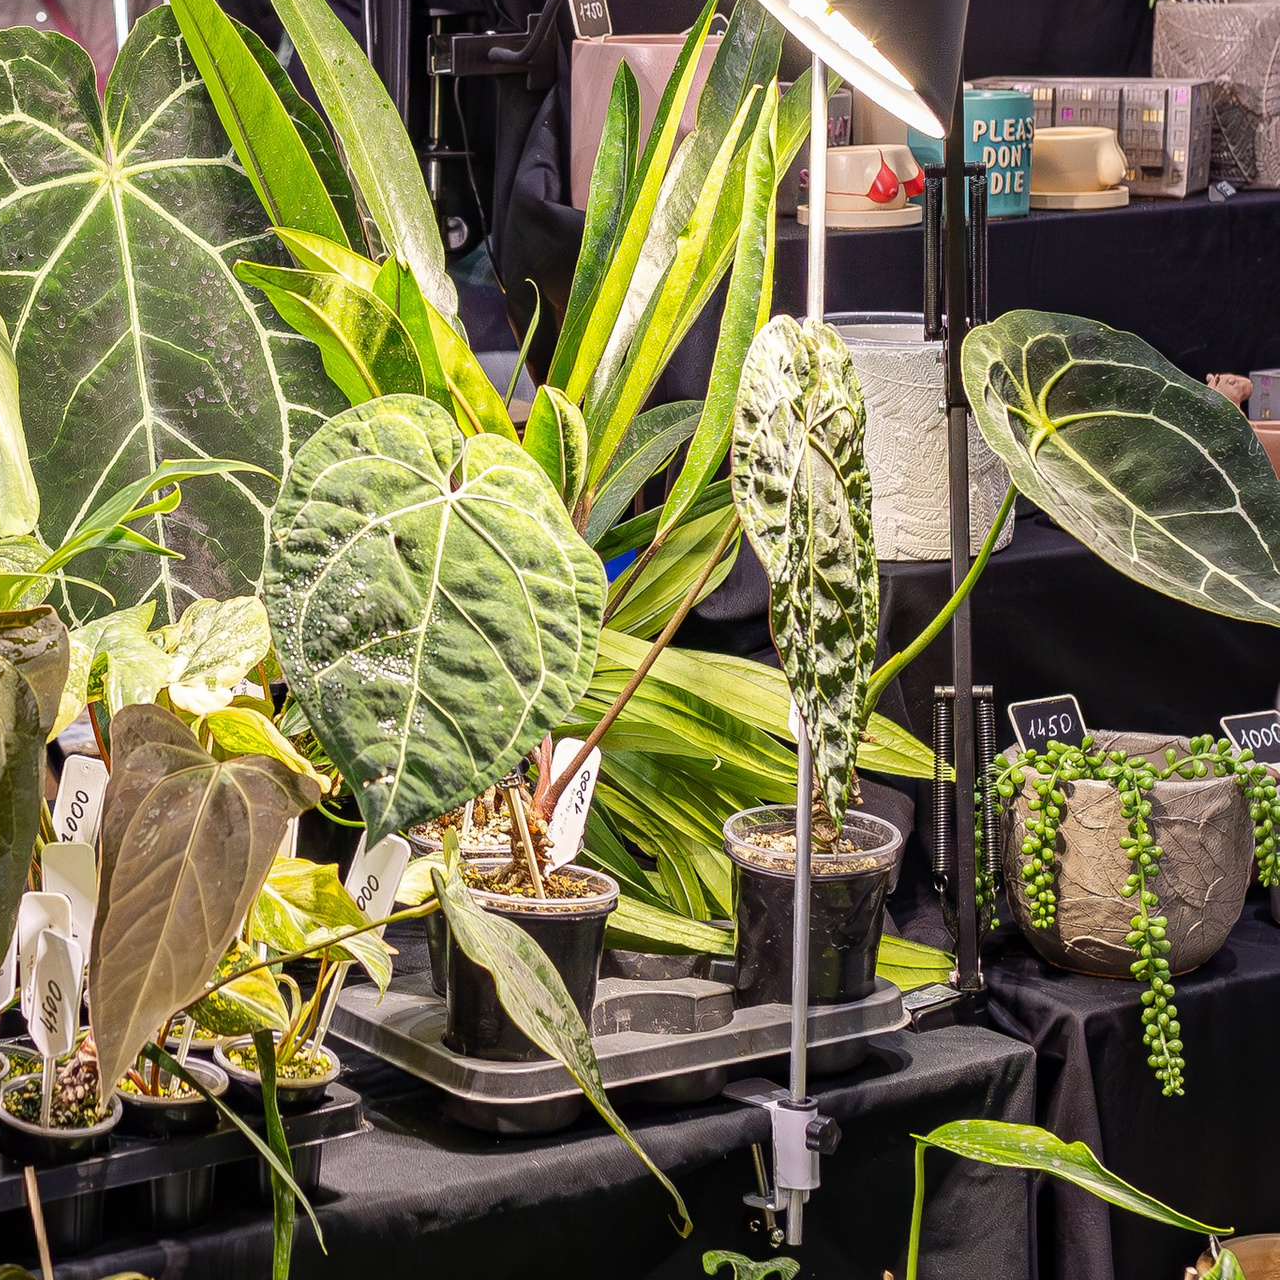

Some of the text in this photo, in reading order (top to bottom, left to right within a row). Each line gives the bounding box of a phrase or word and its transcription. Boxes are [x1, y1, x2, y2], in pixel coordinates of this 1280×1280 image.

[579, 1, 604, 22] 1750
[990, 170, 1025, 195] DIE
[1028, 713, 1072, 739] 1450
[39, 978, 63, 1035] 4500
